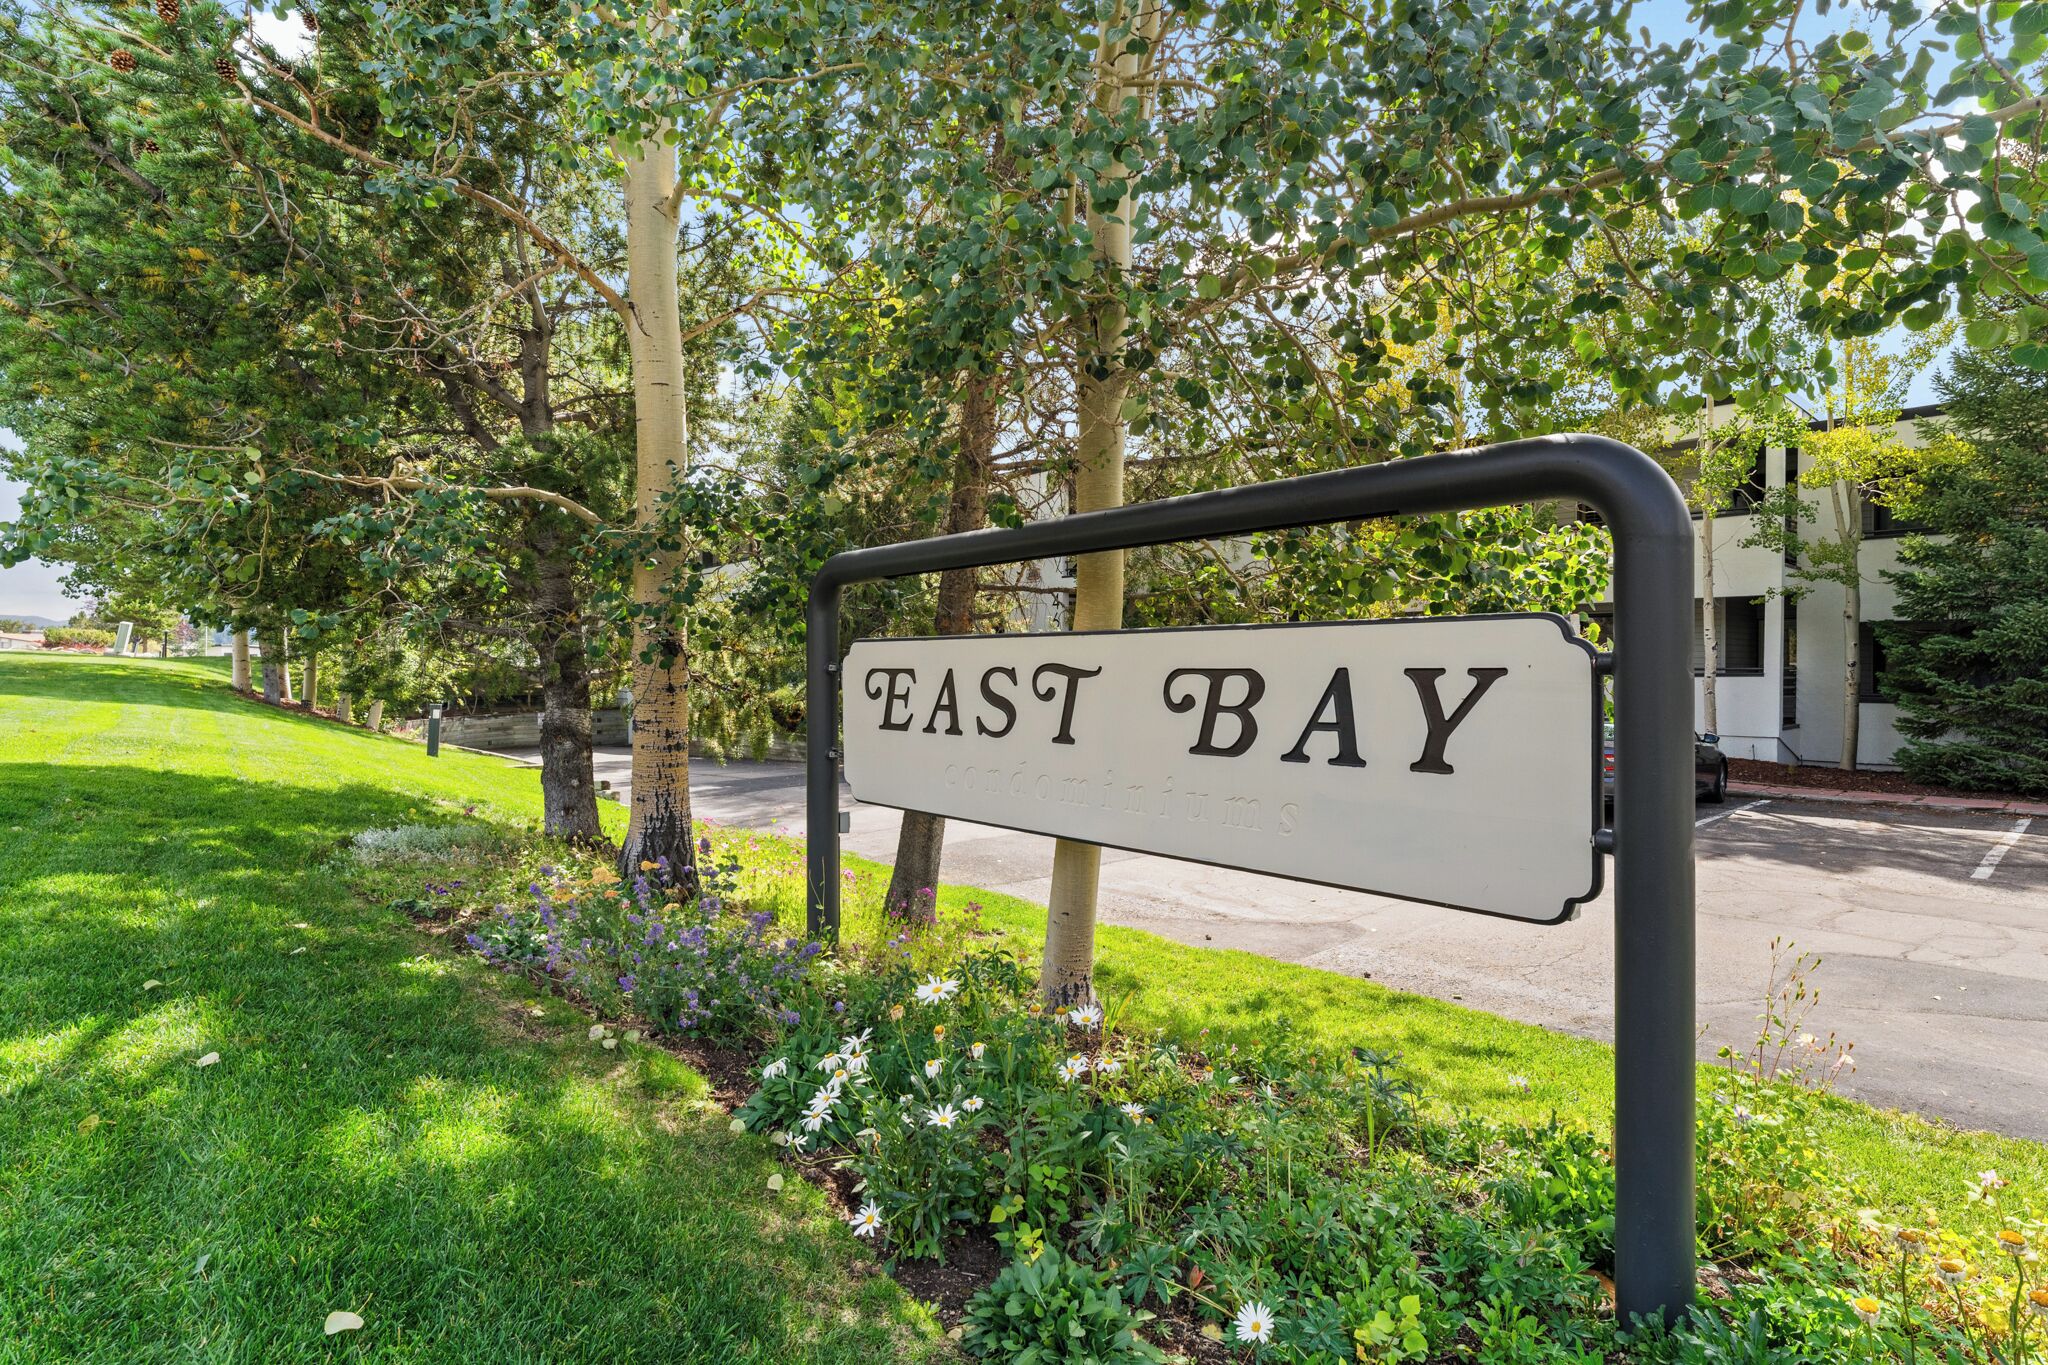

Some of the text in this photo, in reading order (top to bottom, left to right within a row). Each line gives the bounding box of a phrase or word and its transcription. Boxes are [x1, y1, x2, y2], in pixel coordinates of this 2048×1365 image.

[864, 662, 1509, 775] EAST BAY
[944, 761, 1299, 837] condominiums
